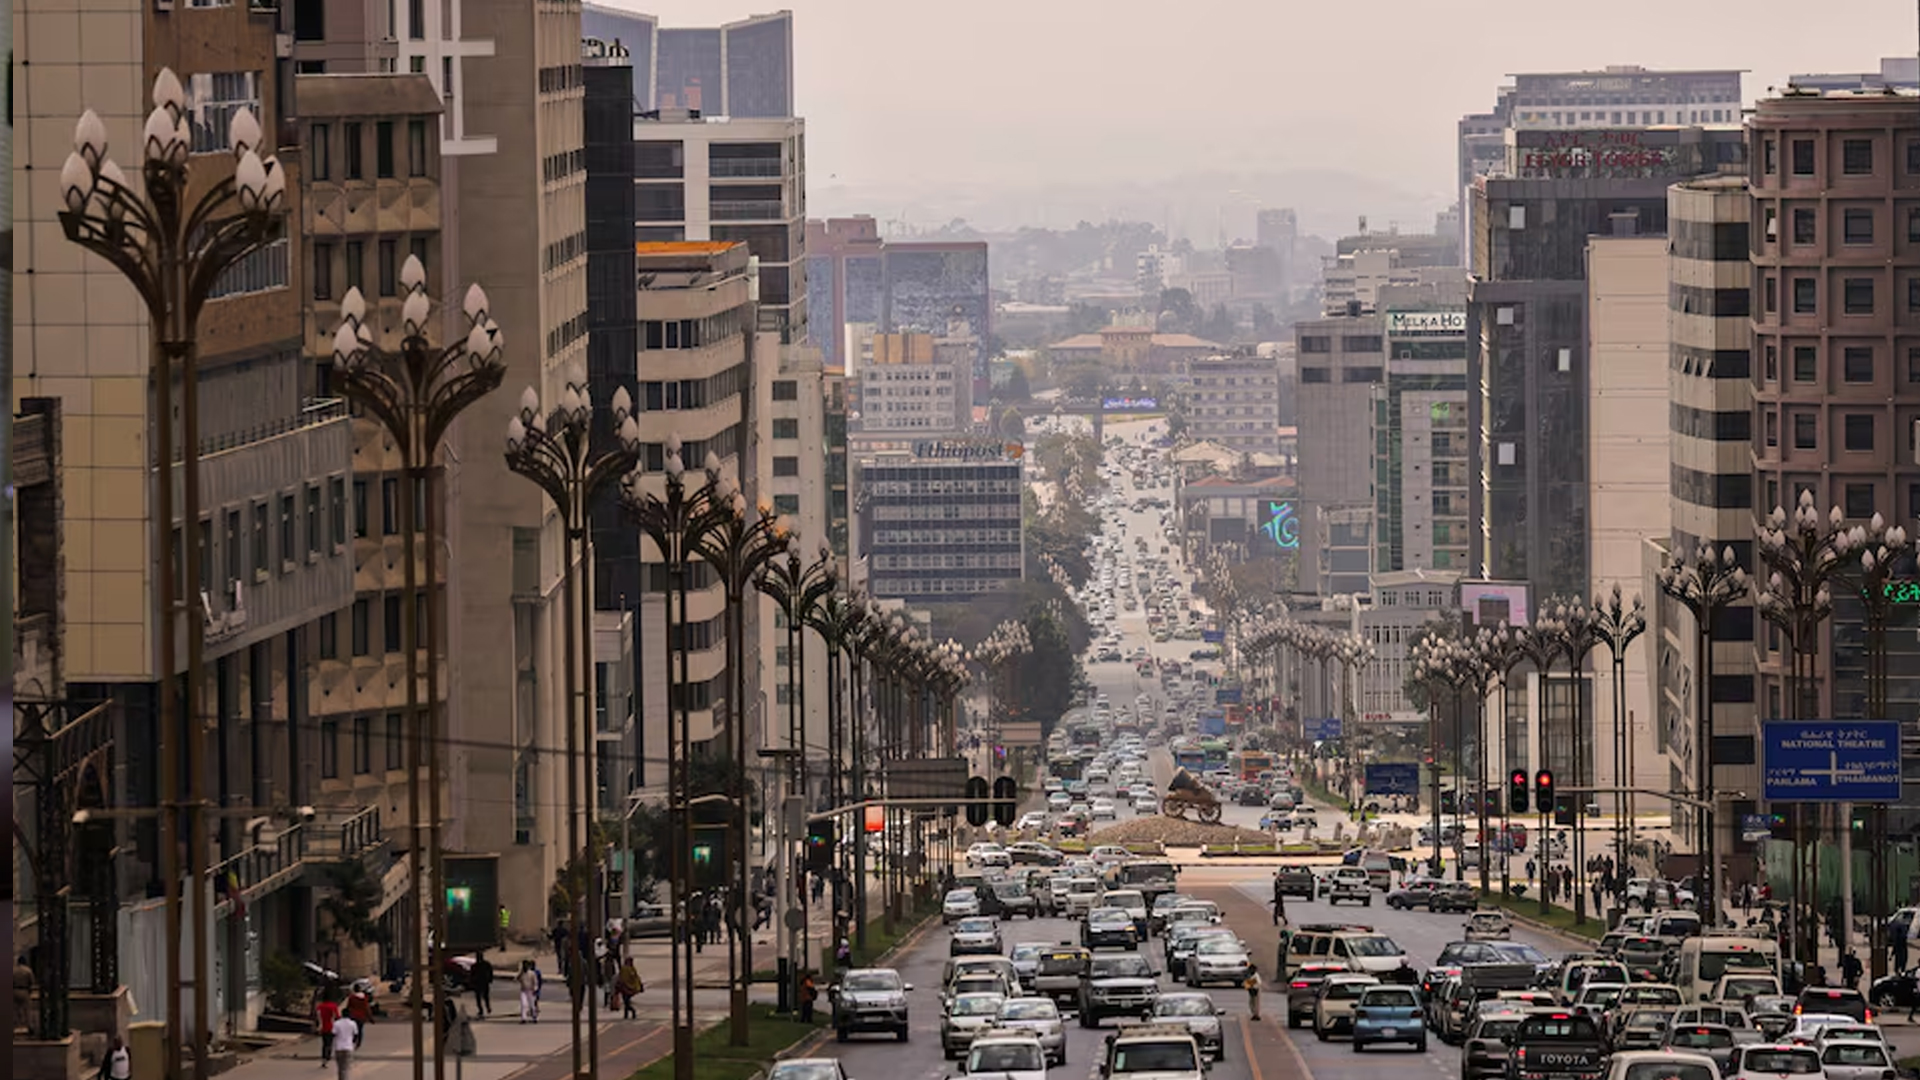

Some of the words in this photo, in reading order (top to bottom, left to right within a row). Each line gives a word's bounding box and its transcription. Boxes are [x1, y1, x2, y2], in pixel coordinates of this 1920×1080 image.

[1393, 313, 1437, 327] MELKA
[916, 440, 1003, 463] Ethiopost
[1781, 739, 1834, 749] NATIONAL
[1838, 739, 1886, 749] THEATRE
[1541, 1053, 1589, 1065] TOYOTA
